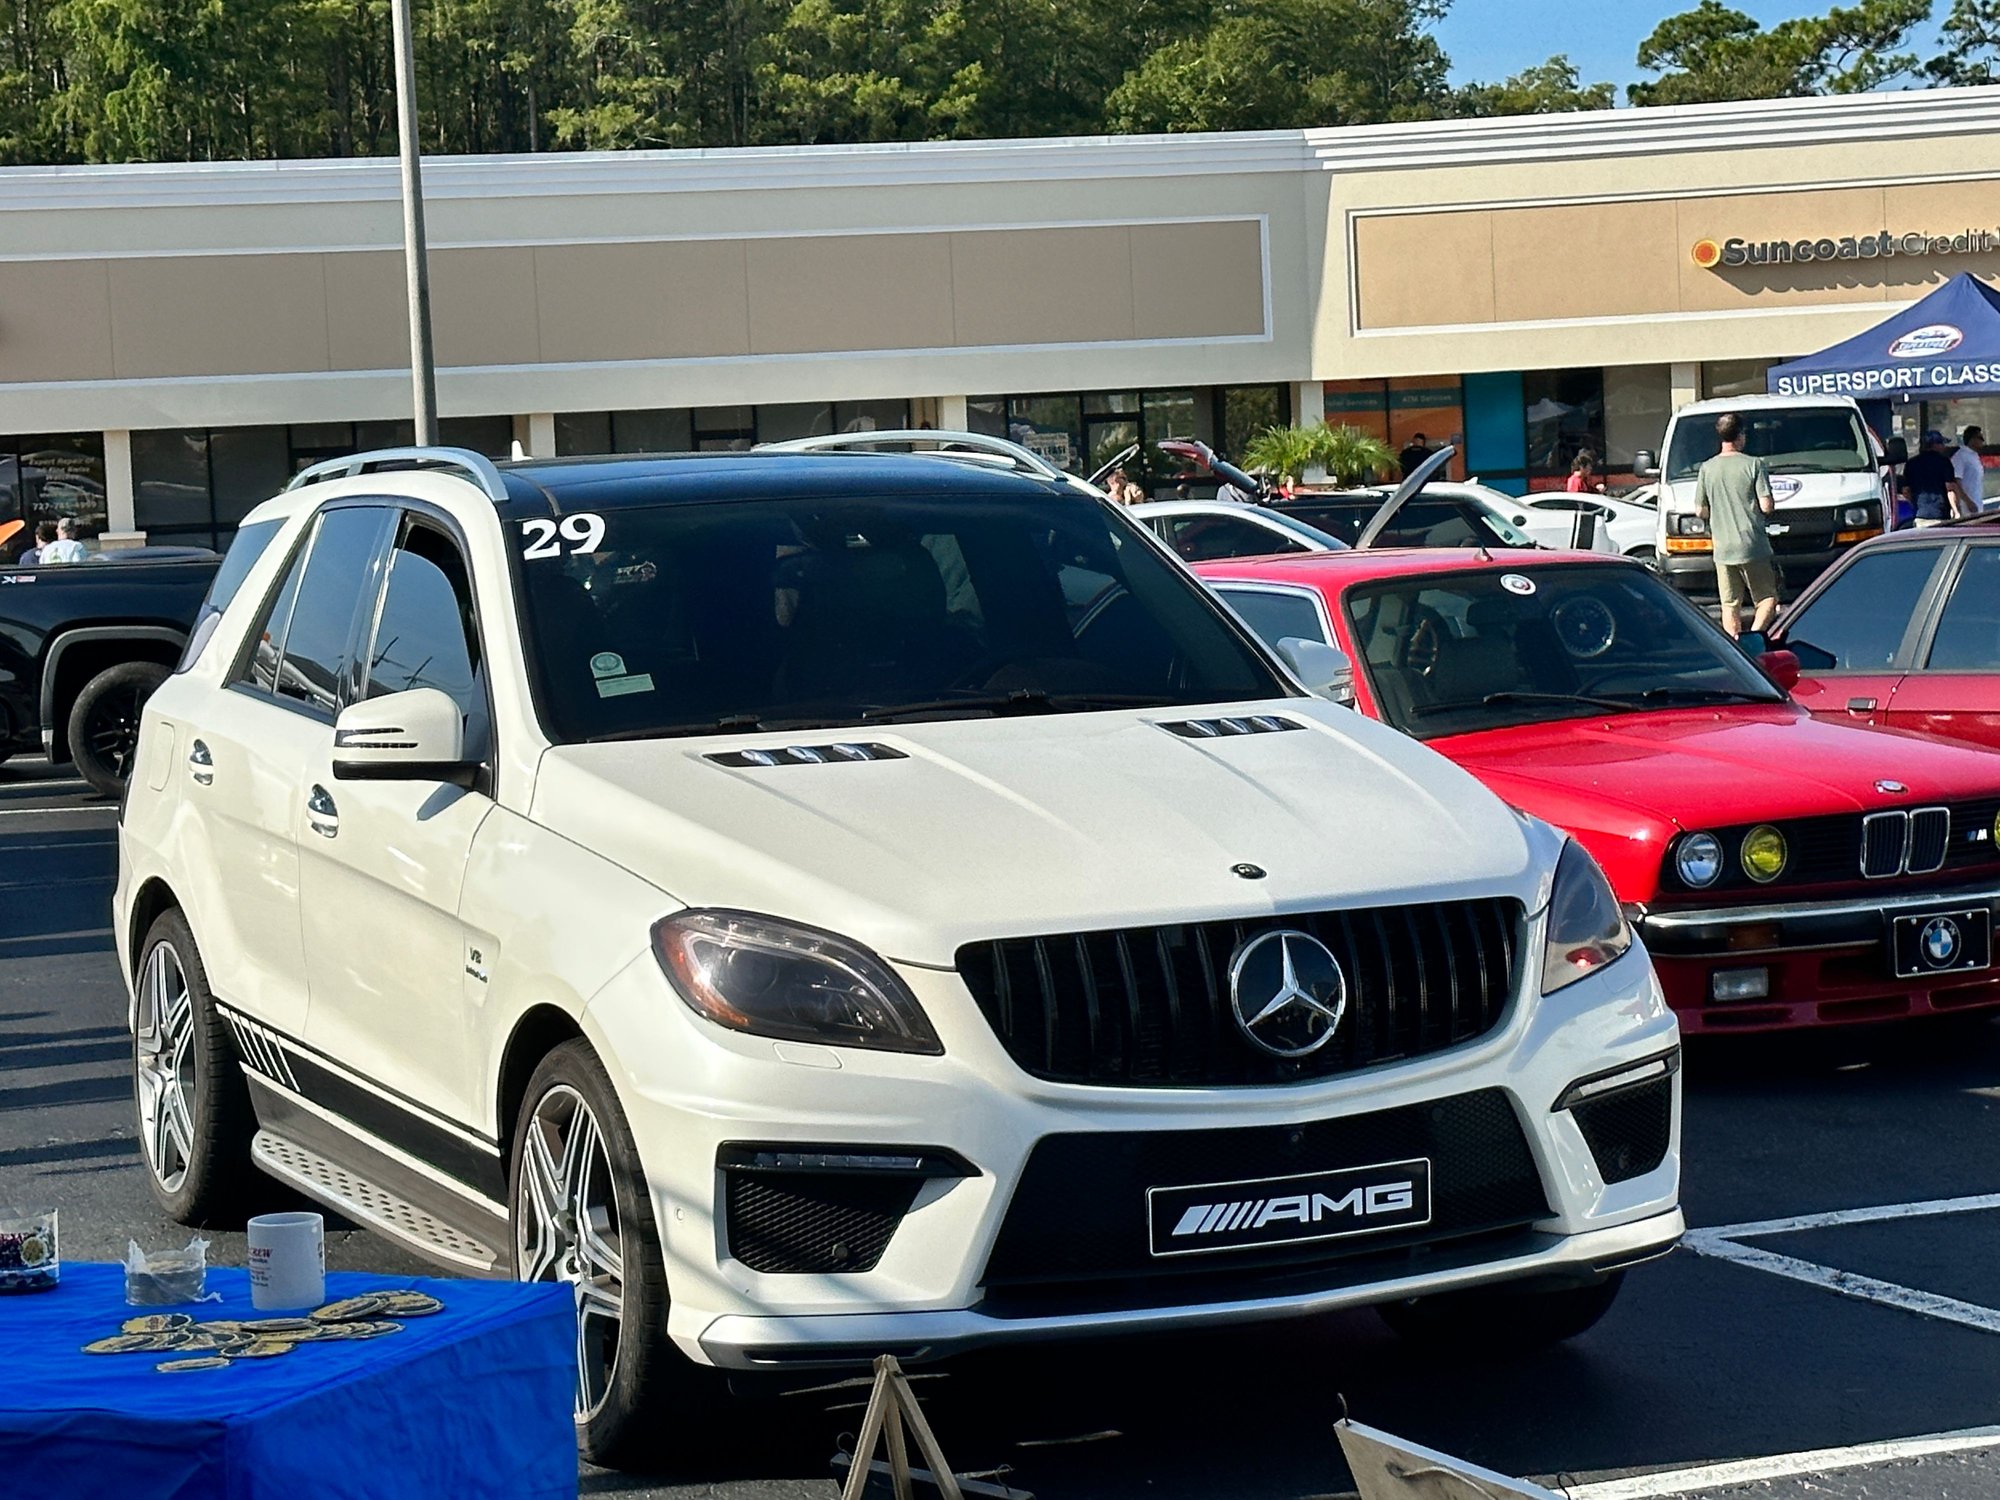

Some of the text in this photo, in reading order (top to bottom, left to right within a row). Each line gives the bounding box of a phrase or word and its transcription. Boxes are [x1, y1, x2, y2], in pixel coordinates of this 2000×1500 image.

[1723, 228, 1992, 266] Suncoast Credit
[1778, 367, 1925, 396] SUPERSPORT
[522, 512, 606, 560] 29
[1253, 1181, 1412, 1228] AMG
